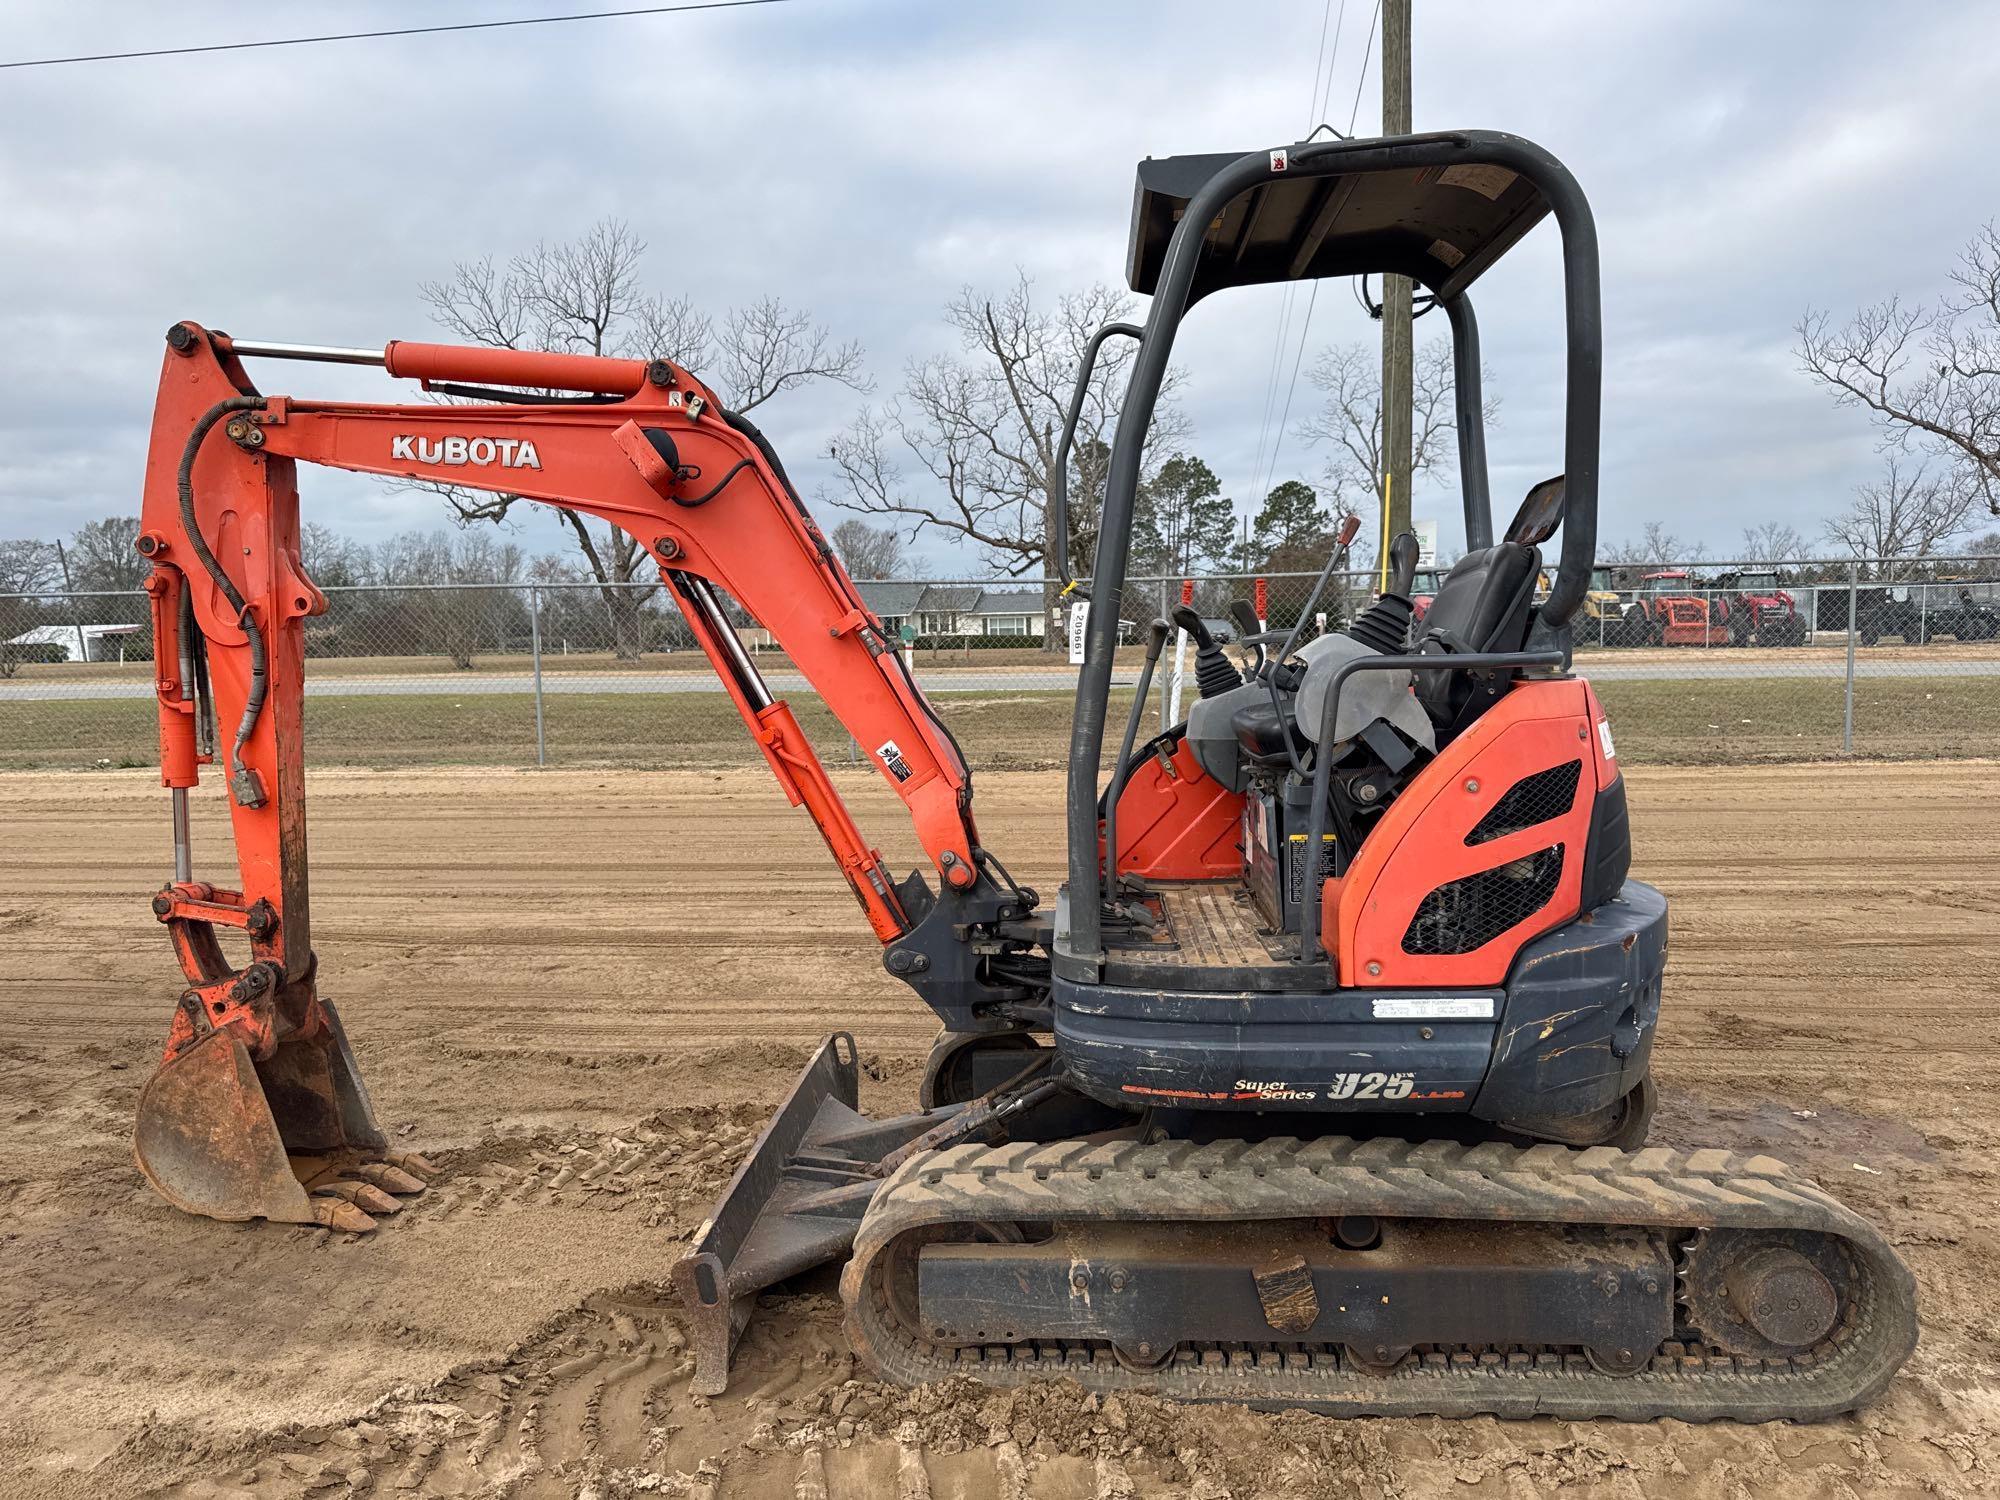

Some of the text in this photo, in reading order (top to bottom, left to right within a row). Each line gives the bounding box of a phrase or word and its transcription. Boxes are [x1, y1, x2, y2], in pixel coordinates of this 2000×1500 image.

[392, 435, 542, 469] KUBOTA
[1074, 615, 1085, 655] 209661
[1234, 1079, 1288, 1093] Super
[1259, 1089, 1317, 1100] Series
[1327, 1072, 1416, 1100] U25
